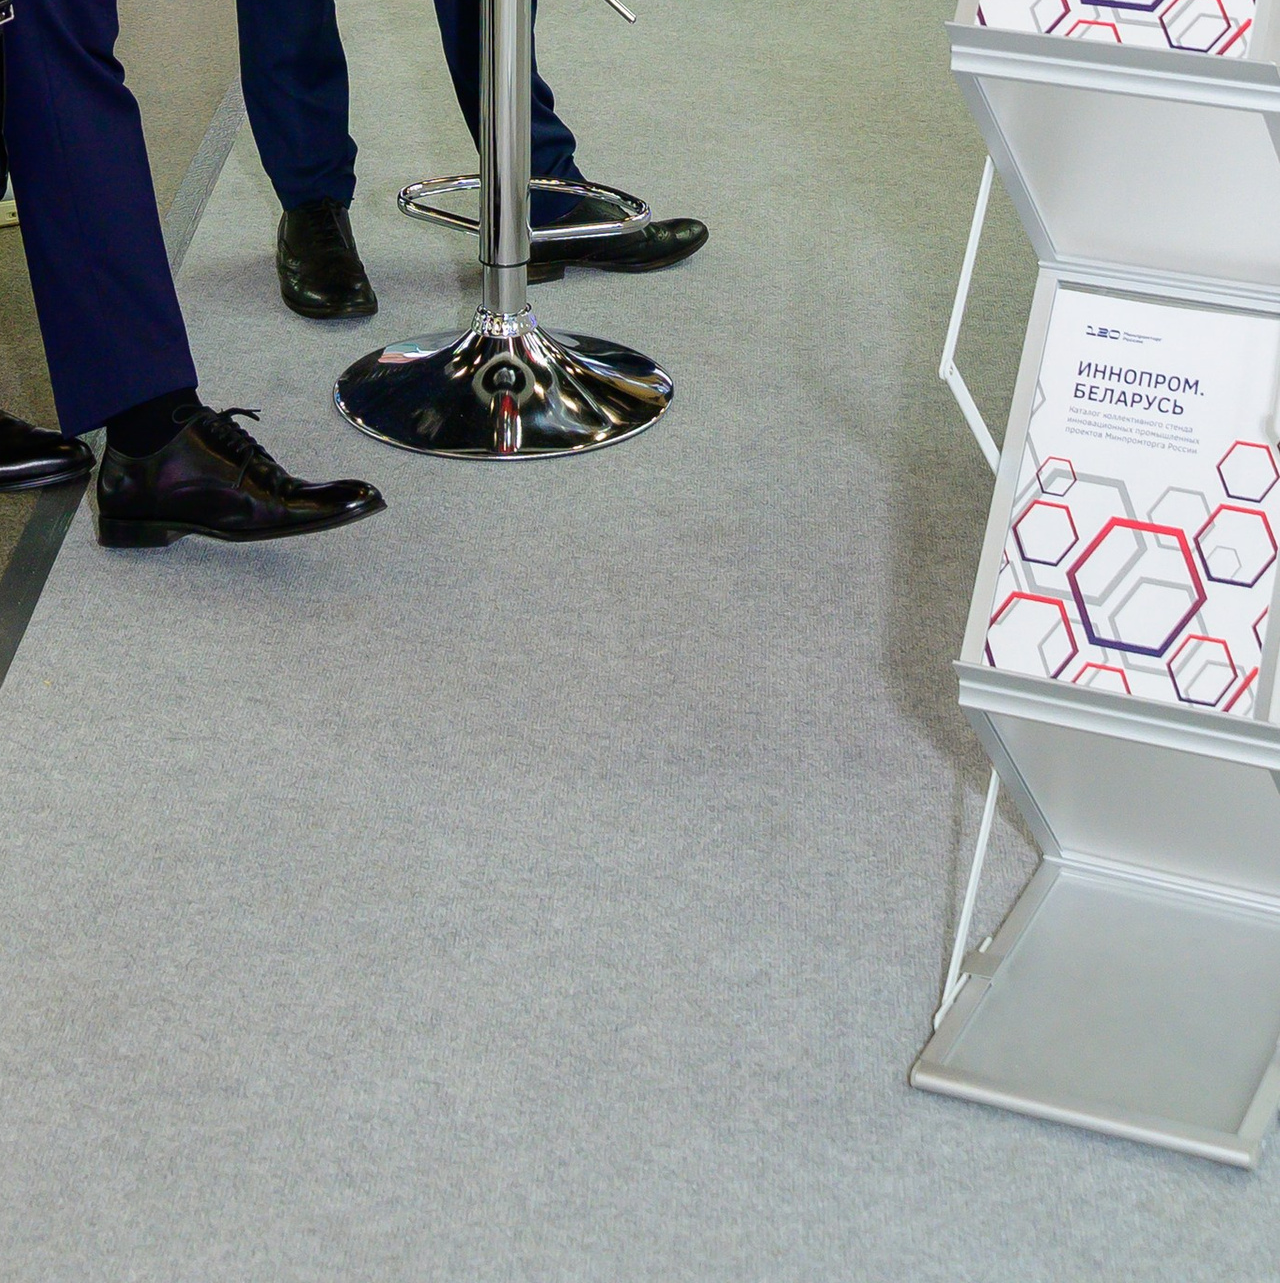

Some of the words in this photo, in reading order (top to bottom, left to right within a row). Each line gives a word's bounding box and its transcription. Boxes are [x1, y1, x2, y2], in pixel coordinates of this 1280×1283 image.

[1077, 360, 1205, 396] ИННОПРОМ.
[1073, 382, 1184, 415] БЕЛАРУСЬ
[1069, 406, 1101, 417] Каталог
[1165, 423, 1193, 433] стенда
[1065, 426, 1103, 438] проектов
[1167, 443, 1198, 455] России
